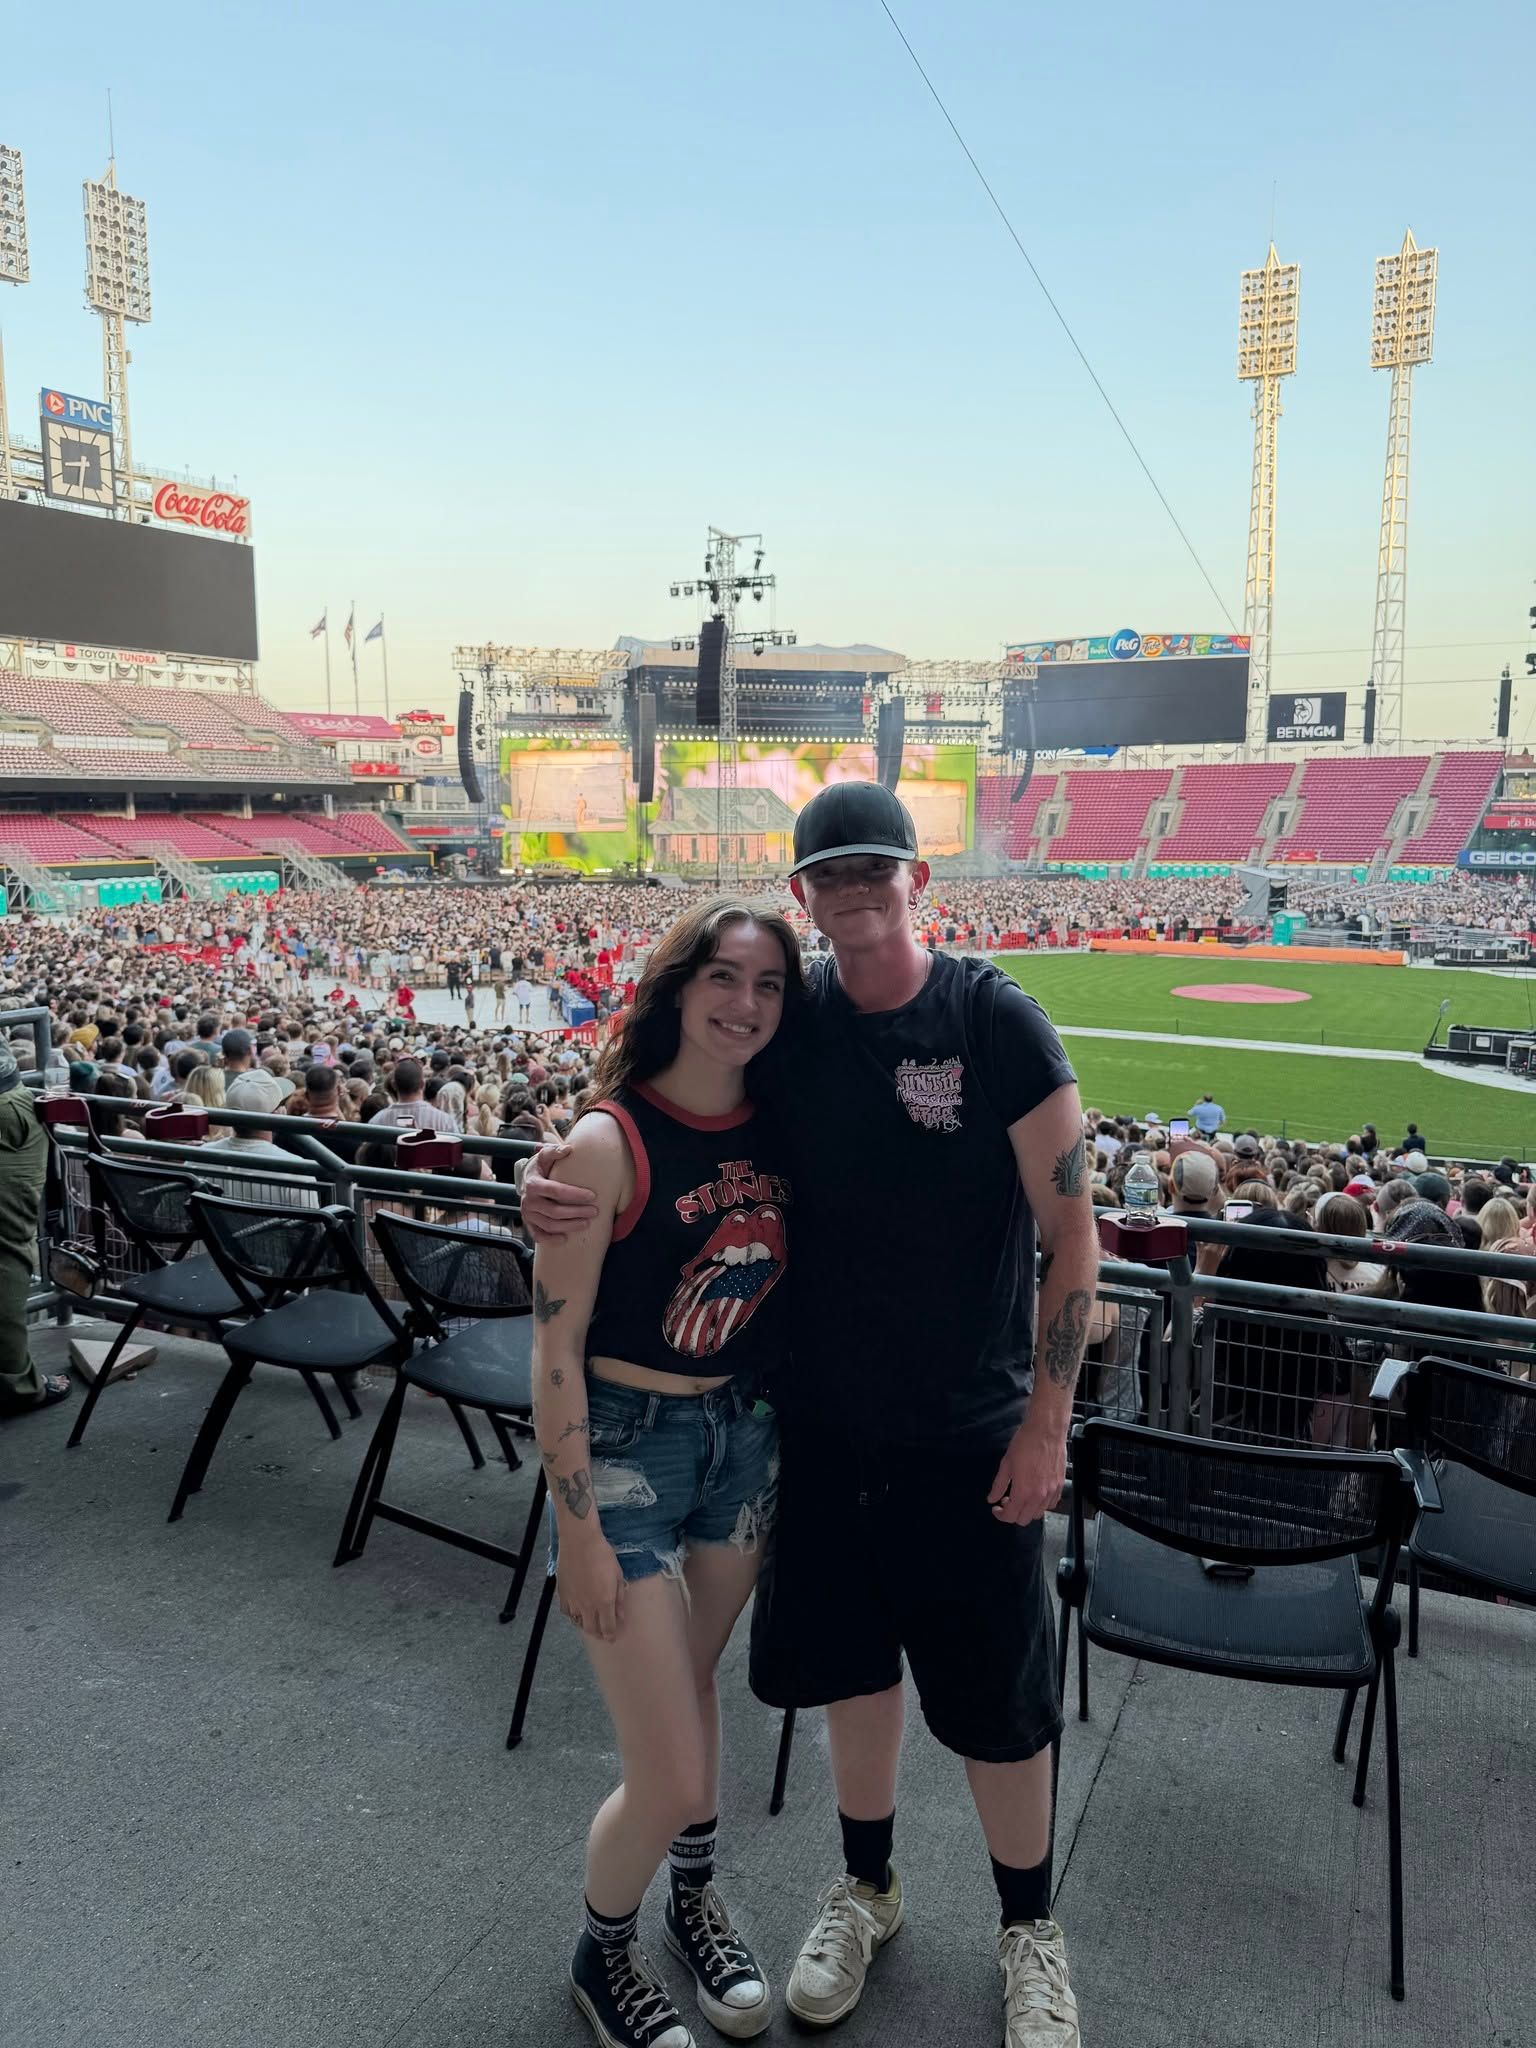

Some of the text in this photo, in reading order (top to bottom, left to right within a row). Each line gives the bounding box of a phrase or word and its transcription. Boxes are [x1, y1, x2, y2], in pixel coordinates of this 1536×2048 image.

[67, 397, 111, 426] PNC
[154, 483, 250, 533] Coca-Cola
[1115, 637, 1139, 651] P&G
[79, 649, 158, 665] TOYOTA TUNDRA
[405, 726, 442, 735] TUNDRA
[1276, 725, 1336, 739] BETMGM
[1014, 749, 1057, 761] BECON
[1469, 850, 1536, 865] GEICO
[718, 1159, 755, 1180] THE
[675, 1174, 793, 1224] STONES
